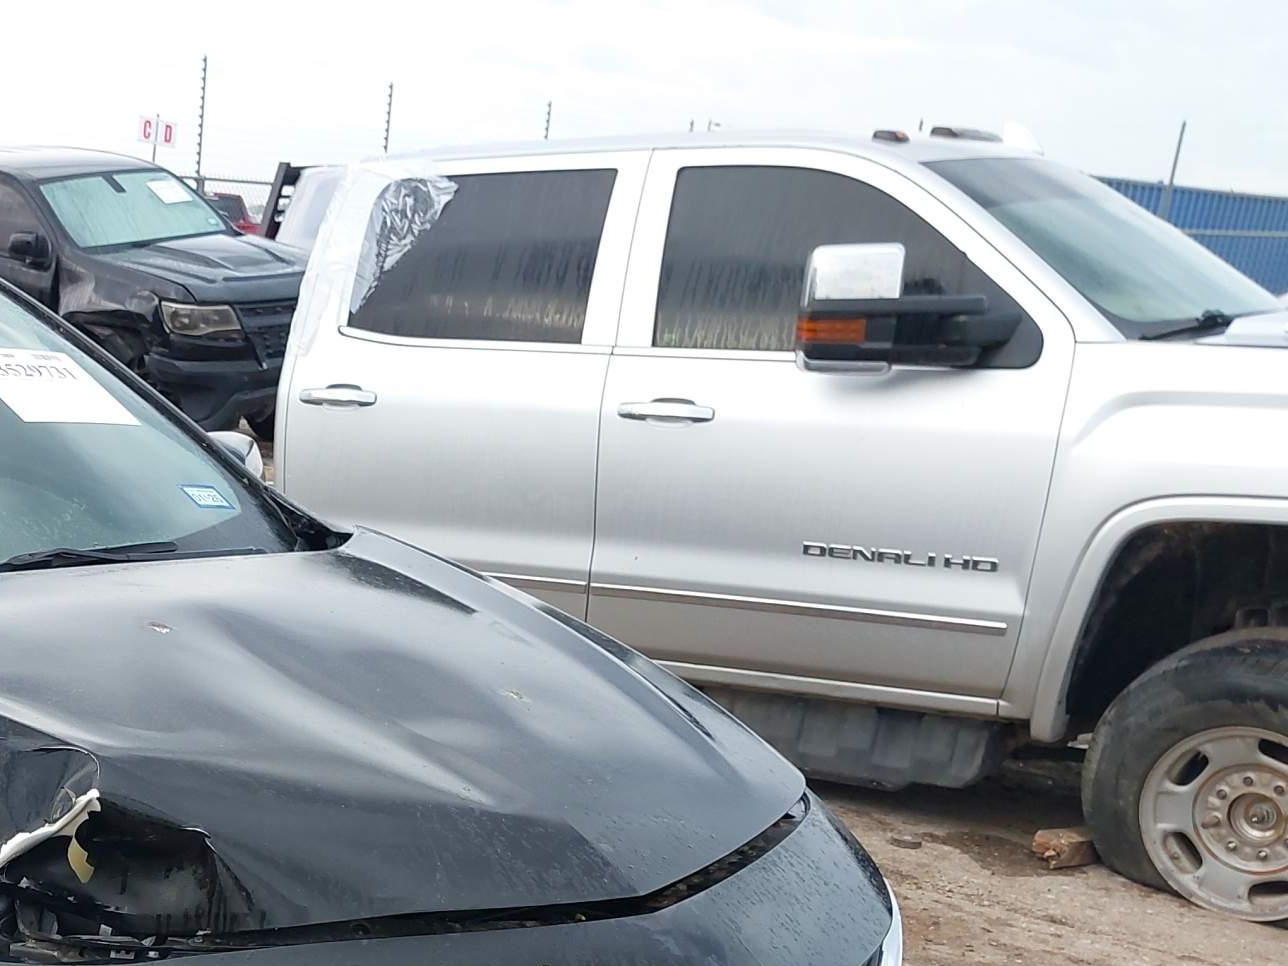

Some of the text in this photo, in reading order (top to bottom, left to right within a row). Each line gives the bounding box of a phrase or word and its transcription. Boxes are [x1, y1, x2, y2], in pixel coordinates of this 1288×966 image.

[143, 120, 152, 140] C
[164, 124, 173, 143] D
[802, 541, 999, 572] DENALI HD
